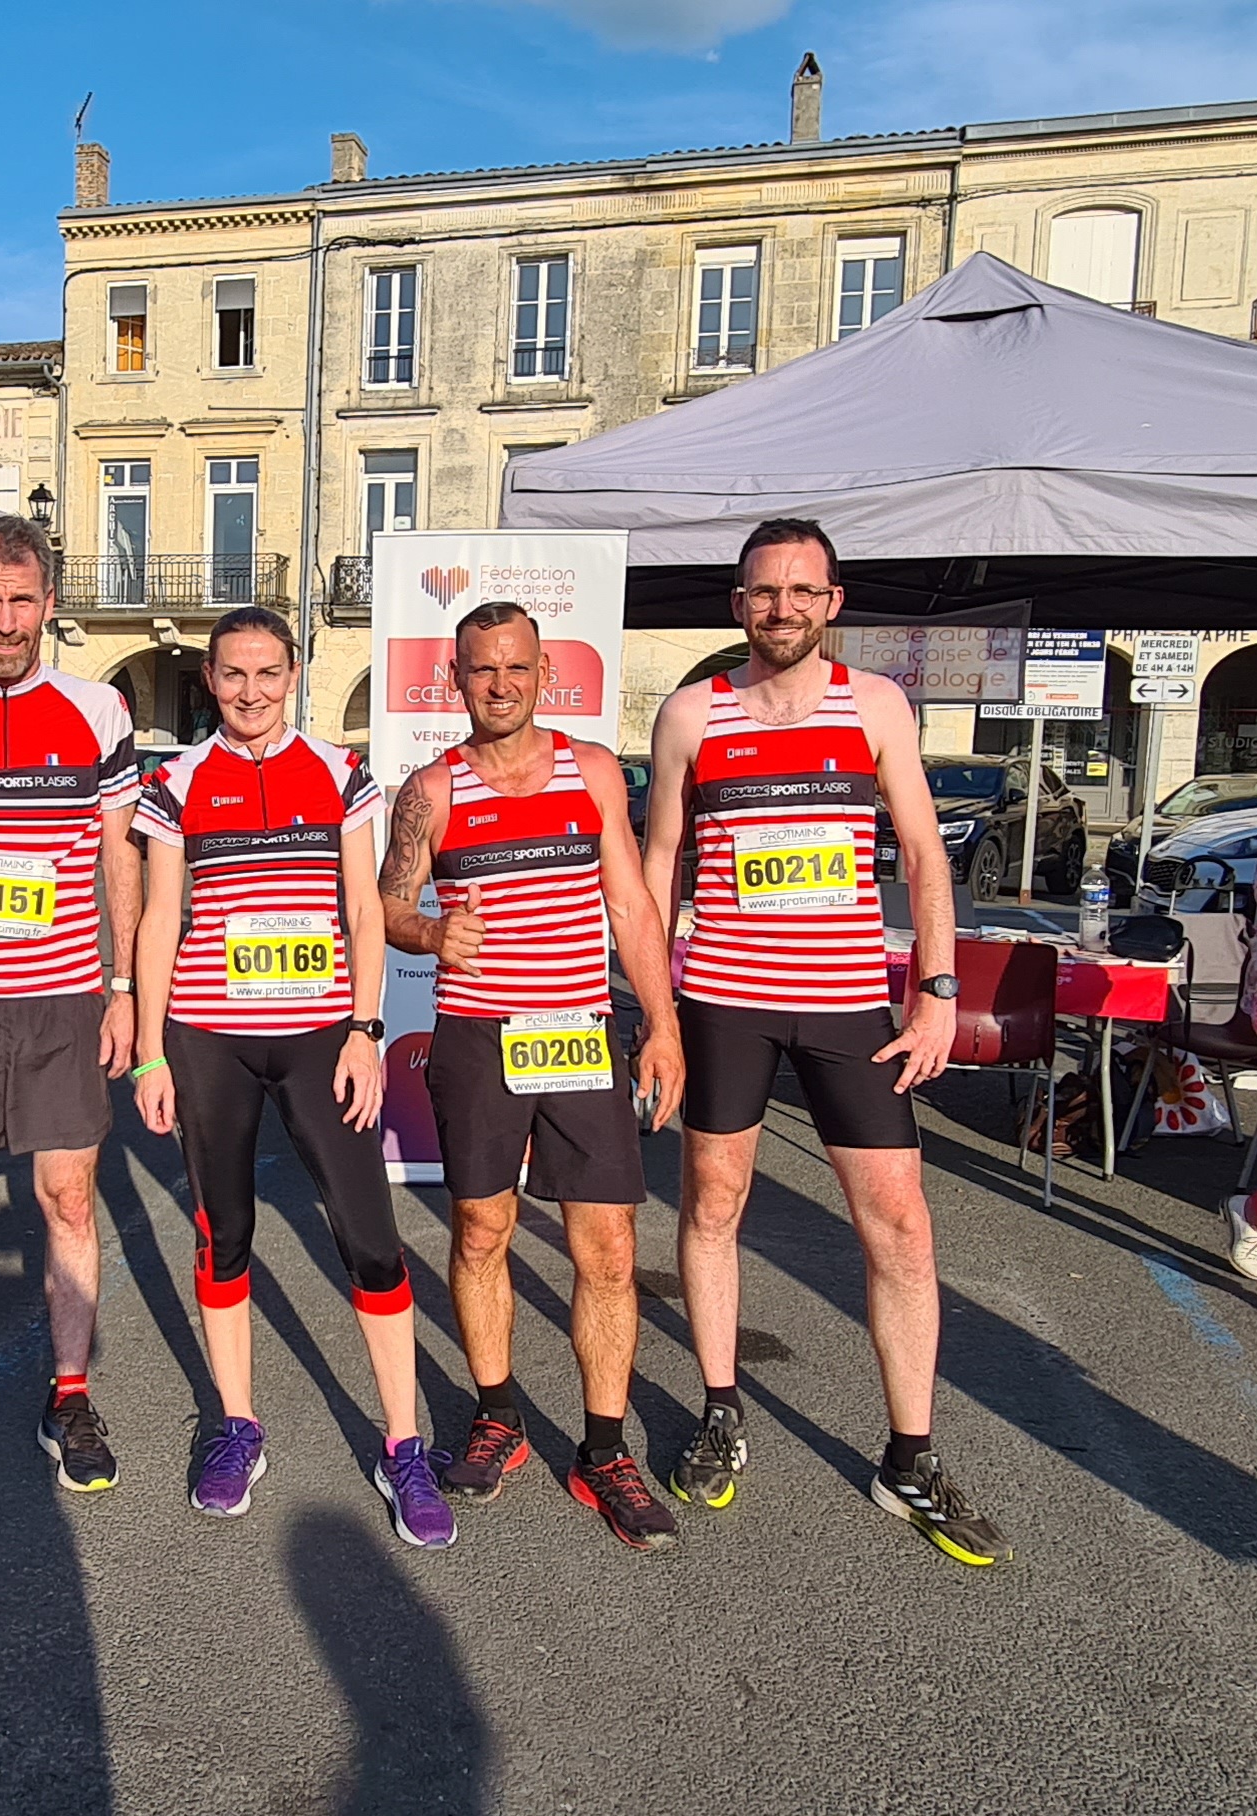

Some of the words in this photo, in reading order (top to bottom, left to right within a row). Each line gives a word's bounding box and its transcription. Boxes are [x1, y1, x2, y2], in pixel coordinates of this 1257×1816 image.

[479, 564, 576, 580] Fédération
[479, 582, 552, 597] Française
[554, 581, 575, 596] de
[1140, 639, 1193, 649] MERCREDI
[859, 644, 972, 665] Française
[977, 642, 1008, 662] de
[1138, 652, 1152, 660] ET
[1154, 652, 1193, 661] SAMEDI
[1135, 664, 1148, 672] DE
[405, 685, 464, 705] CŒU
[983, 705, 1024, 716] DISQUE
[1026, 706, 1099, 718] OBLIGATOIRE
[412, 730, 461, 742] VENEZ
[34, 775, 78, 788] PLAISIRS
[719, 784, 771, 803] BOULIAC
[770, 783, 811, 797] SPORTS
[810, 781, 852, 795] PLAISIRS
[290, 831, 329, 843] PLAISIRS
[759, 826, 827, 842] PROTIMING
[460, 850, 513, 870] BOULIAC
[513, 846, 556, 861] SPORTS
[556, 843, 593, 857] PLAISIRS
[743, 852, 849, 888] 60214
[747, 893, 848, 910] www.protiming.fr
[249, 916, 312, 928] PROTIMING
[232, 942, 328, 974] 60169
[235, 984, 327, 998] www.protiming.fr
[509, 1037, 603, 1069] 60208
[513, 1076, 604, 1092] www.protiming.fr
